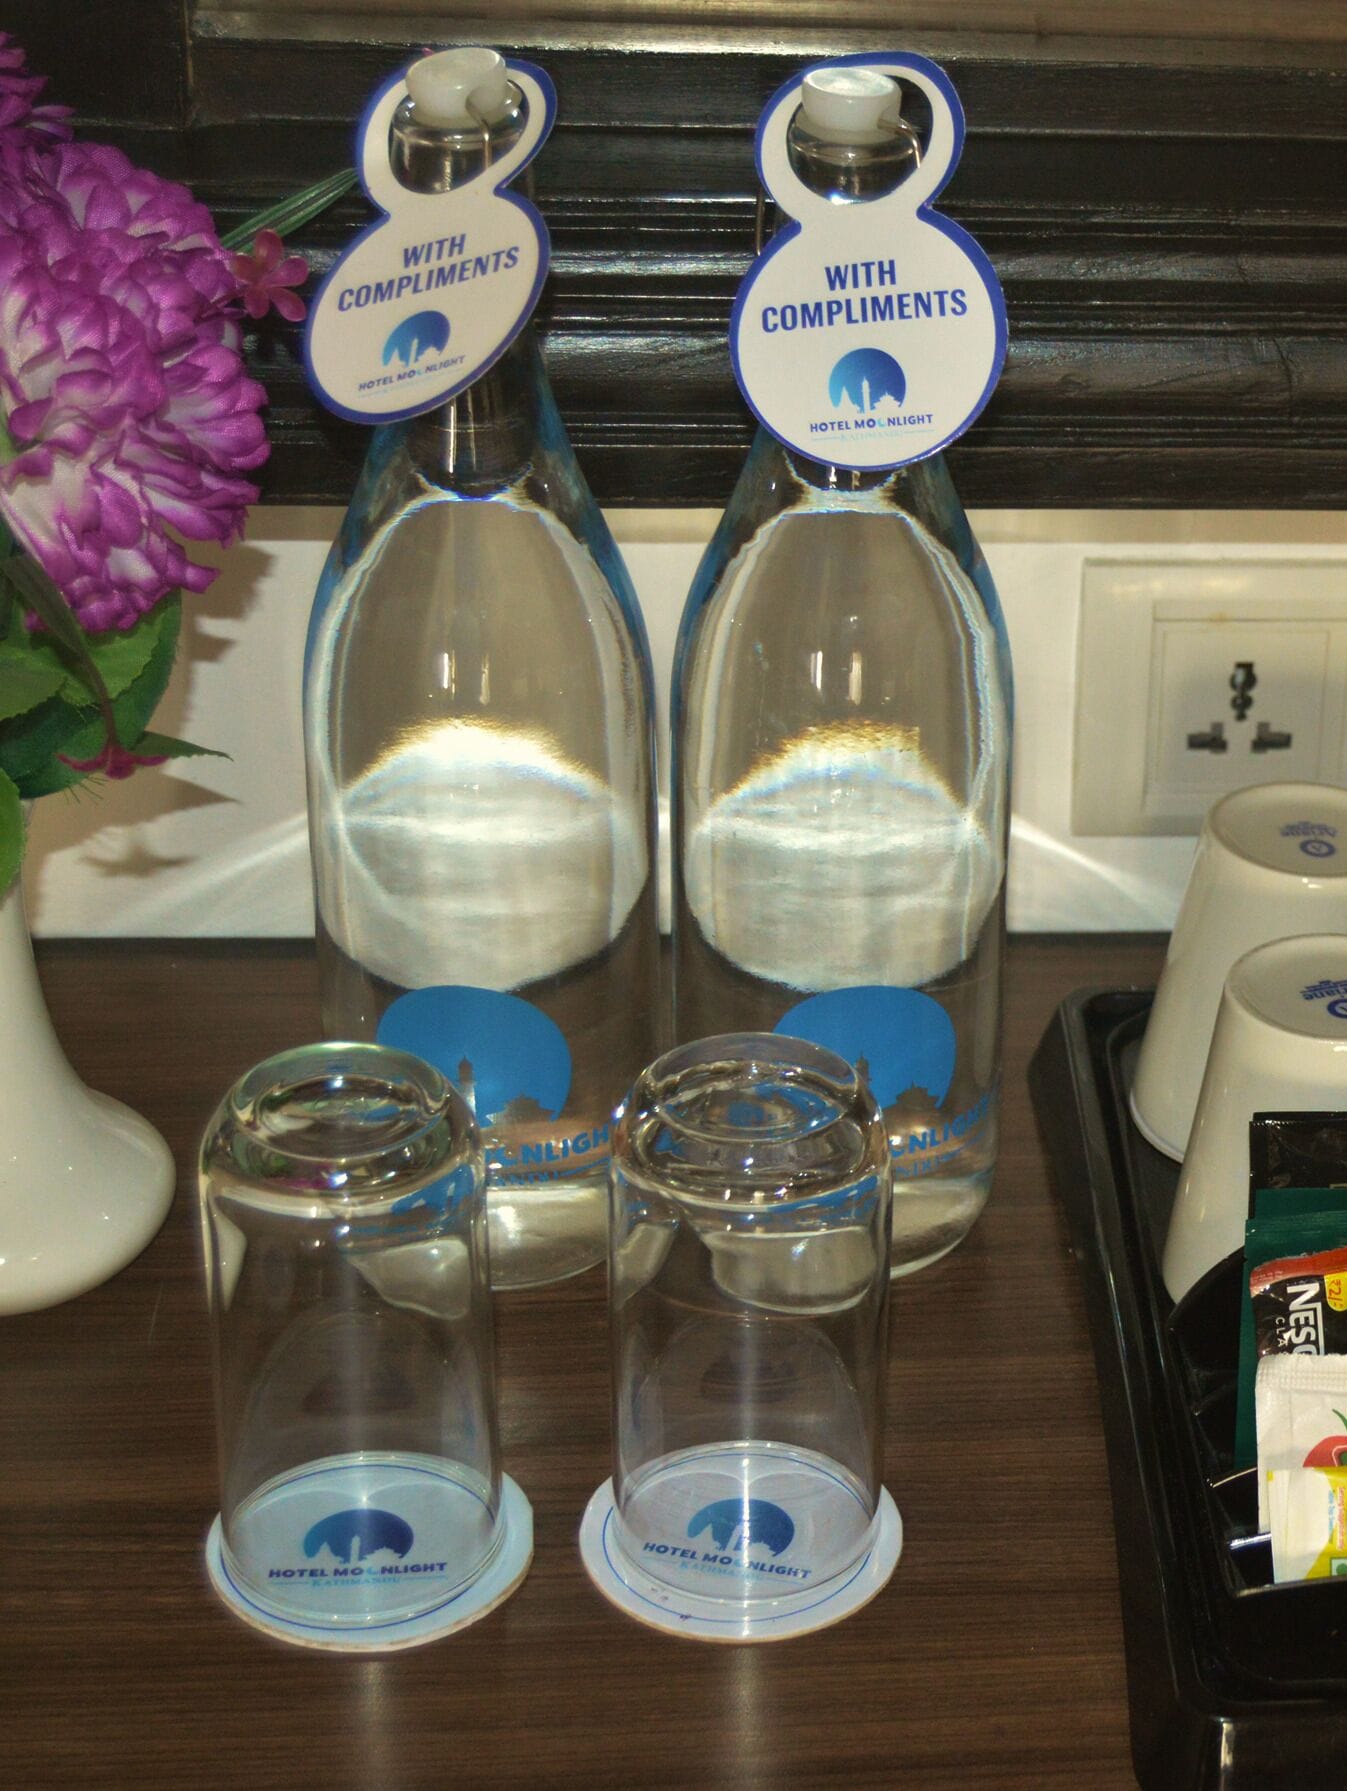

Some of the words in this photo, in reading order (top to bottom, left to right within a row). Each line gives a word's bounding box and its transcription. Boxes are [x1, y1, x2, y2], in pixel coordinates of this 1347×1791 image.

[403, 234, 467, 268] WITH
[338, 246, 520, 312] COMPLIMENTS
[825, 259, 896, 291] WITH
[762, 288, 967, 333] COMPLIMENTS
[358, 376, 393, 392] HOTEL
[810, 421, 851, 432] HOTEL
[1275, 1316, 1287, 1354] CLA
[643, 1542, 698, 1560] HOTEL
[268, 1568, 328, 1578] HOTEL
